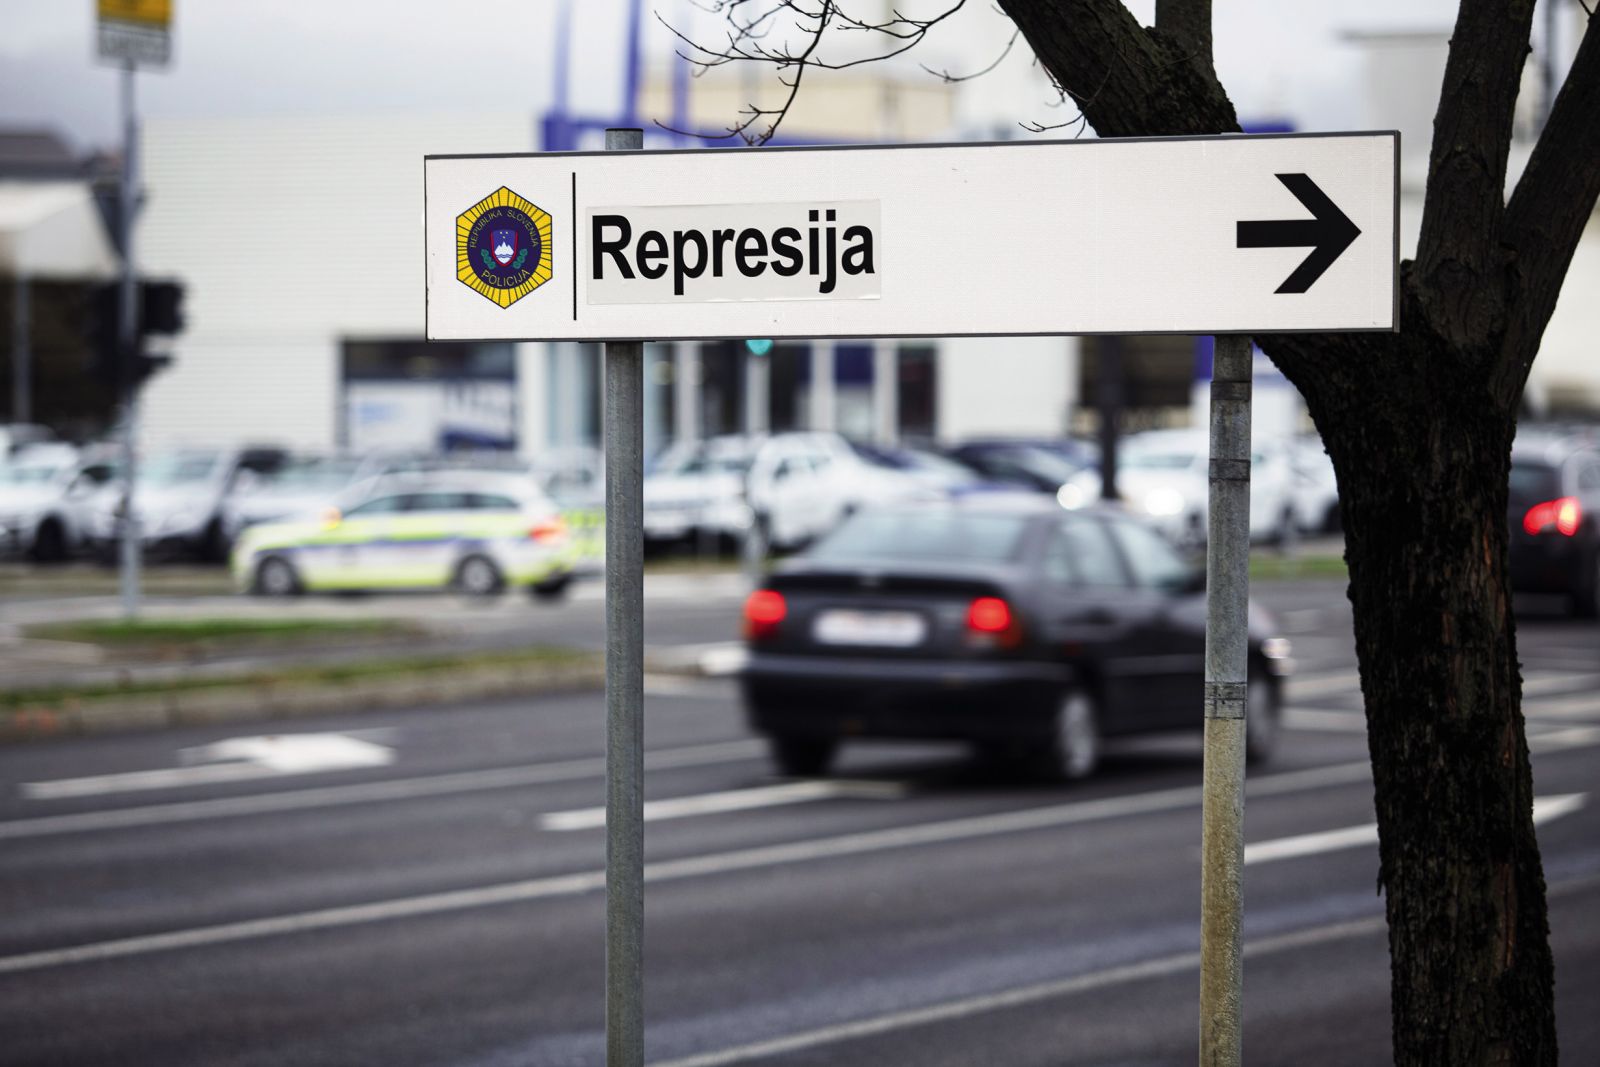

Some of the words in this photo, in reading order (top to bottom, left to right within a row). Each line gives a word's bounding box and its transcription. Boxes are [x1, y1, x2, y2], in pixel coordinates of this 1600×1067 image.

[470, 209, 503, 248] REPUBLIKA
[507, 209, 540, 248] SLOVENIJA
[592, 209, 875, 295] Represija
[481, 268, 530, 287] POLICIJA
